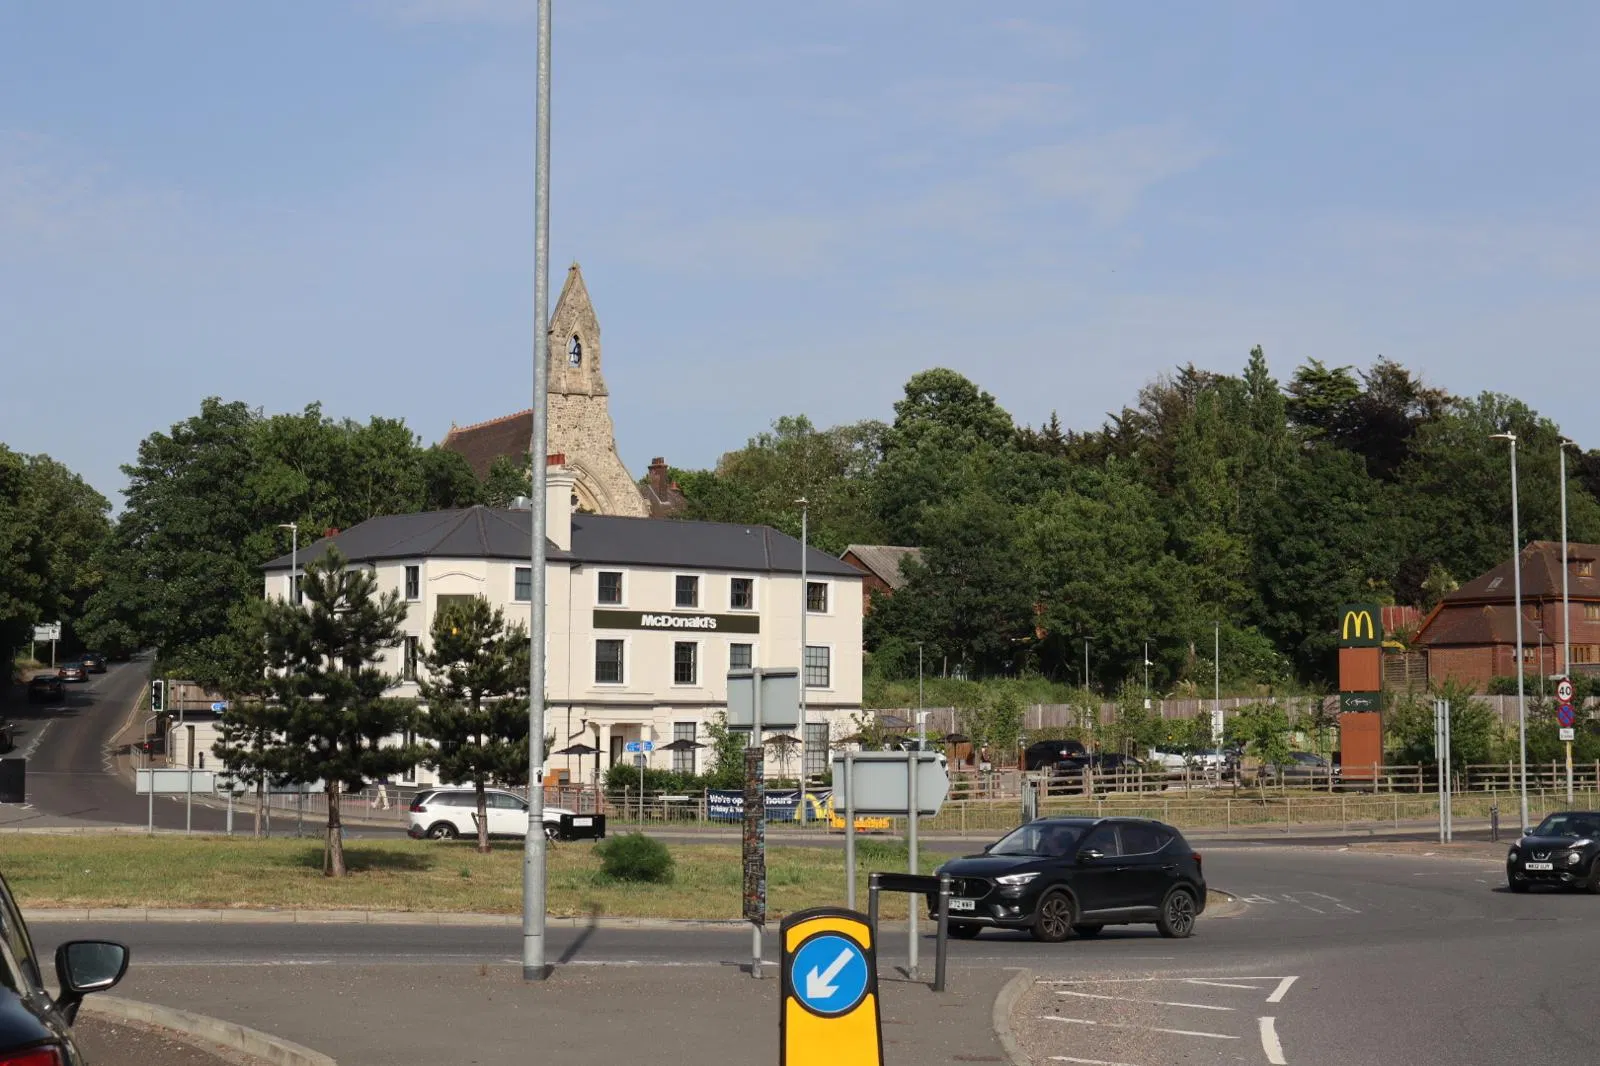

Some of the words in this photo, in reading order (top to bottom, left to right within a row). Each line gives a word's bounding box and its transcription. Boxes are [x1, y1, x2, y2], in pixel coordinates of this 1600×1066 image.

[640, 614, 717, 629] McDonald's
[1560, 686, 1571, 696] 40
[709, 794, 731, 804] We're
[732, 797, 744, 807] op
[765, 796, 792, 805] hours
[711, 805, 729, 813] Friday
